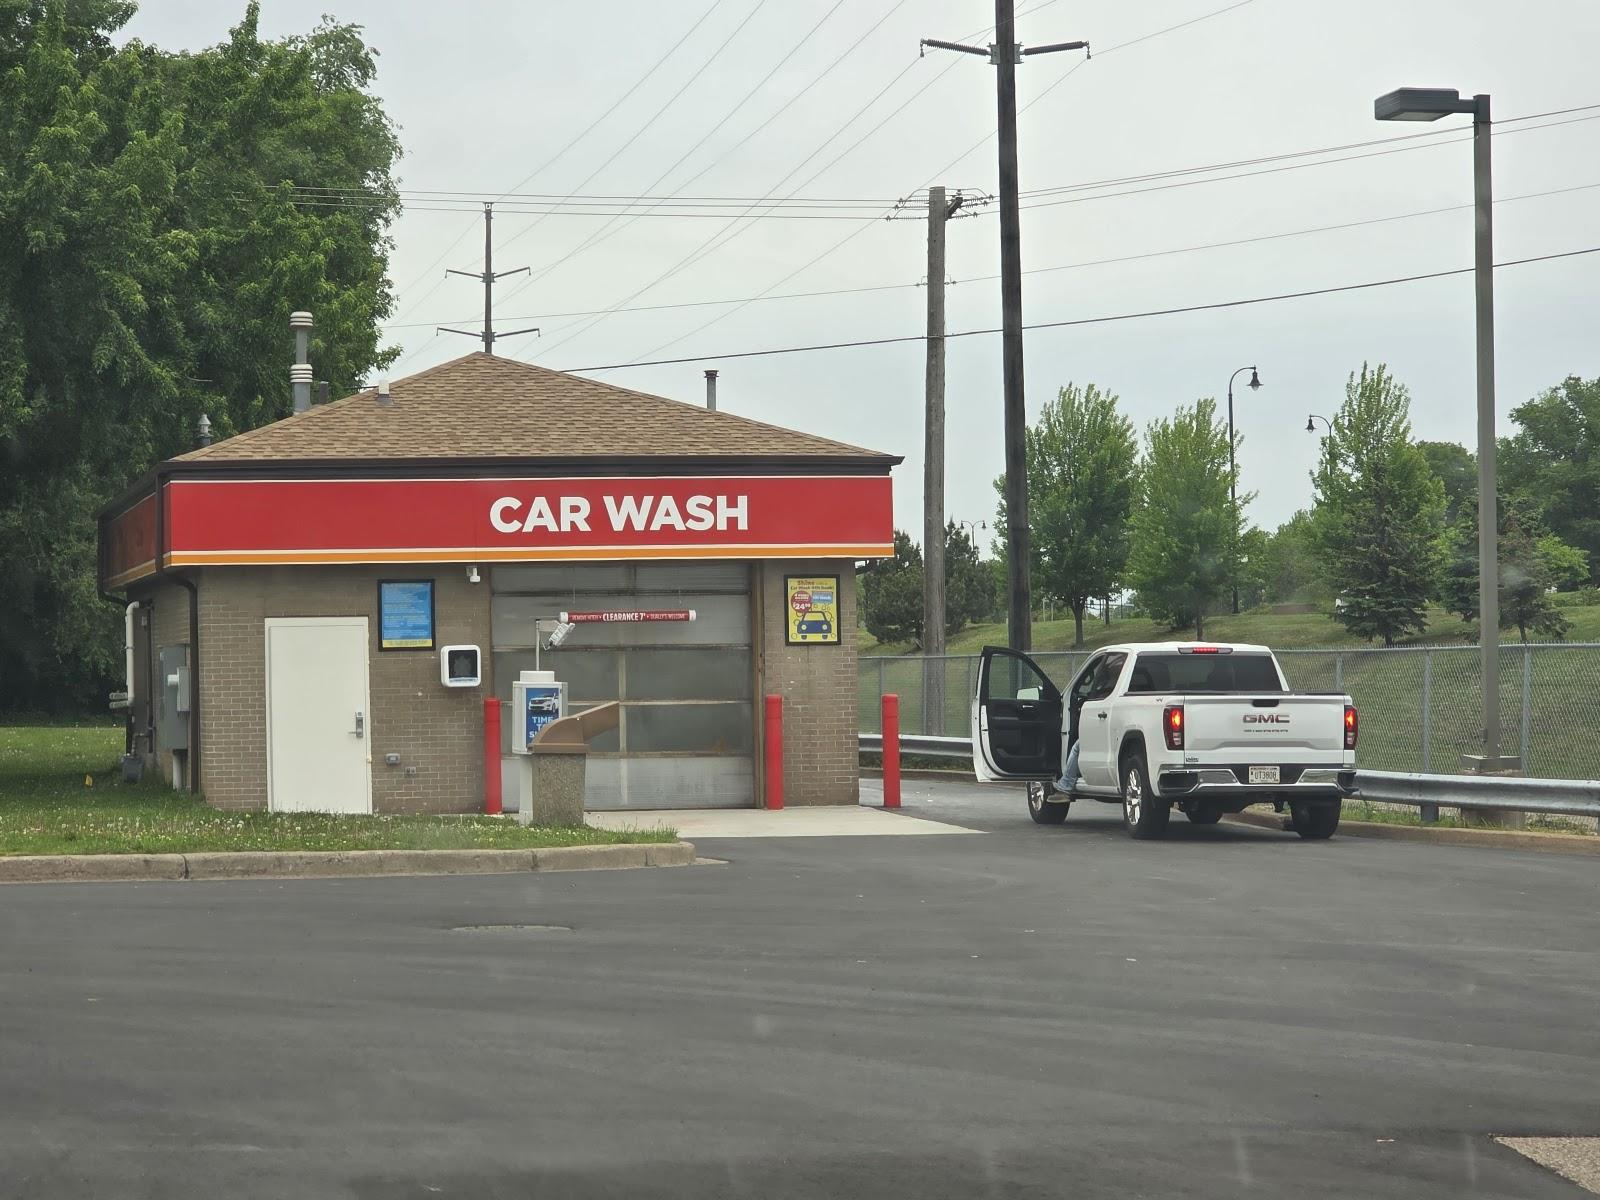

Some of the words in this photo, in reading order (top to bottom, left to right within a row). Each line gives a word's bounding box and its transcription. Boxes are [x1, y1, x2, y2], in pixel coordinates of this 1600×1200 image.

[490, 496, 592, 533] CAR
[603, 495, 749, 532] WASH
[602, 612, 639, 622] CLEARANCE
[1243, 715, 1290, 723] GMC
